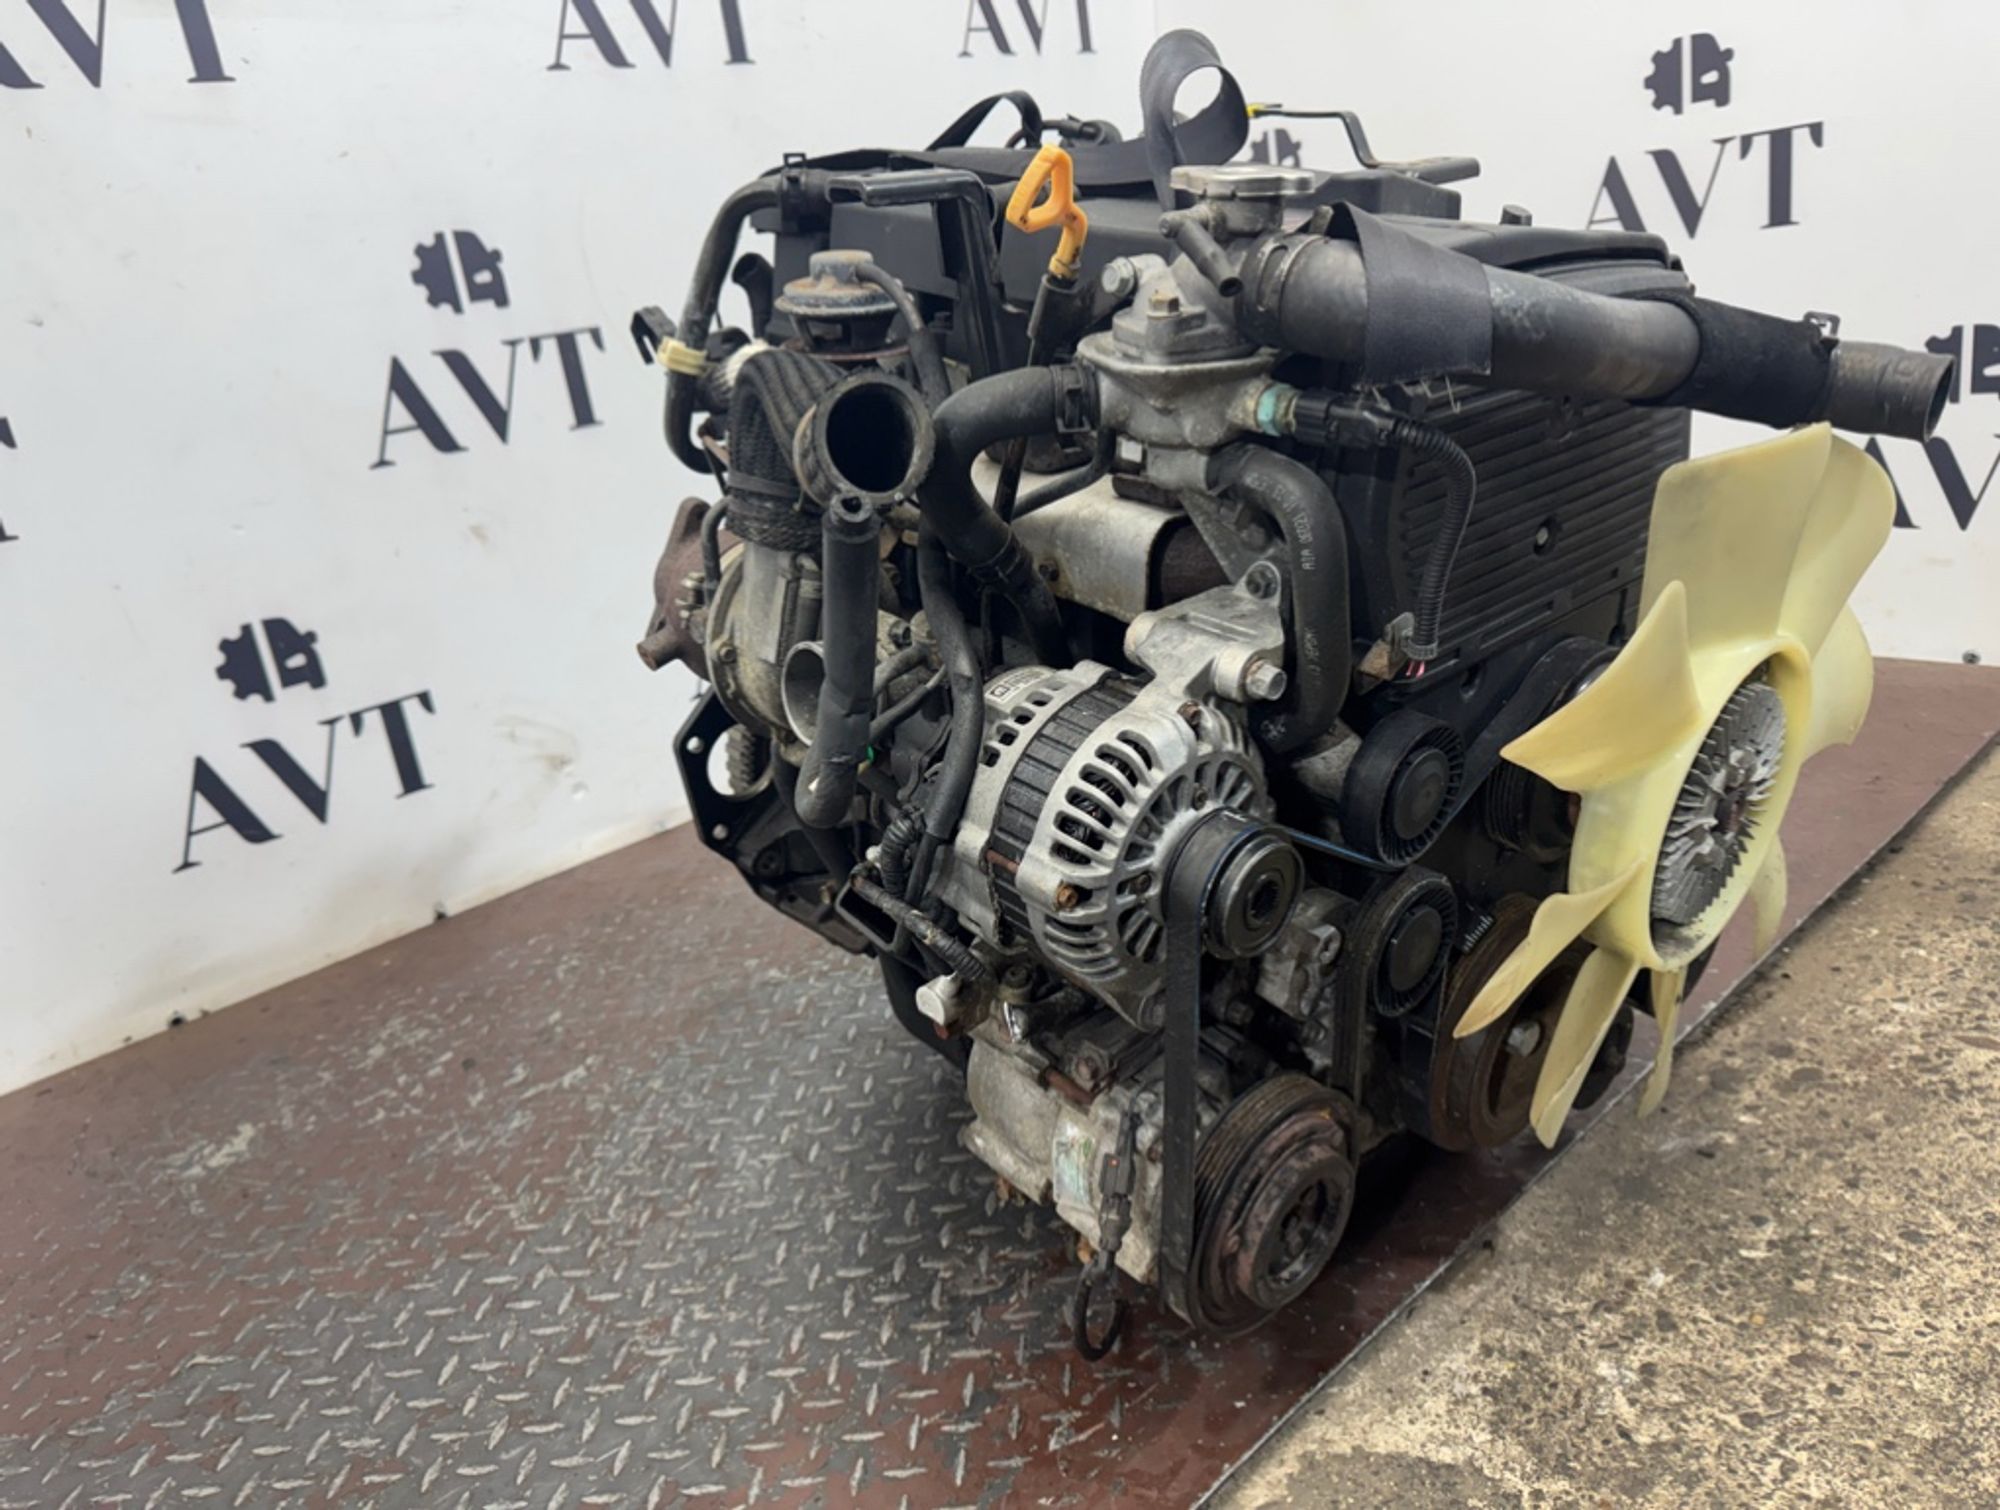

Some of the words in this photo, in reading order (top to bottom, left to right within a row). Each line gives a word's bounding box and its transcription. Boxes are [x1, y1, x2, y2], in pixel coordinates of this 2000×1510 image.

[1587, 121, 1824, 239] AVT
[369, 326, 606, 470] AVT
[172, 689, 436, 874] AVT
